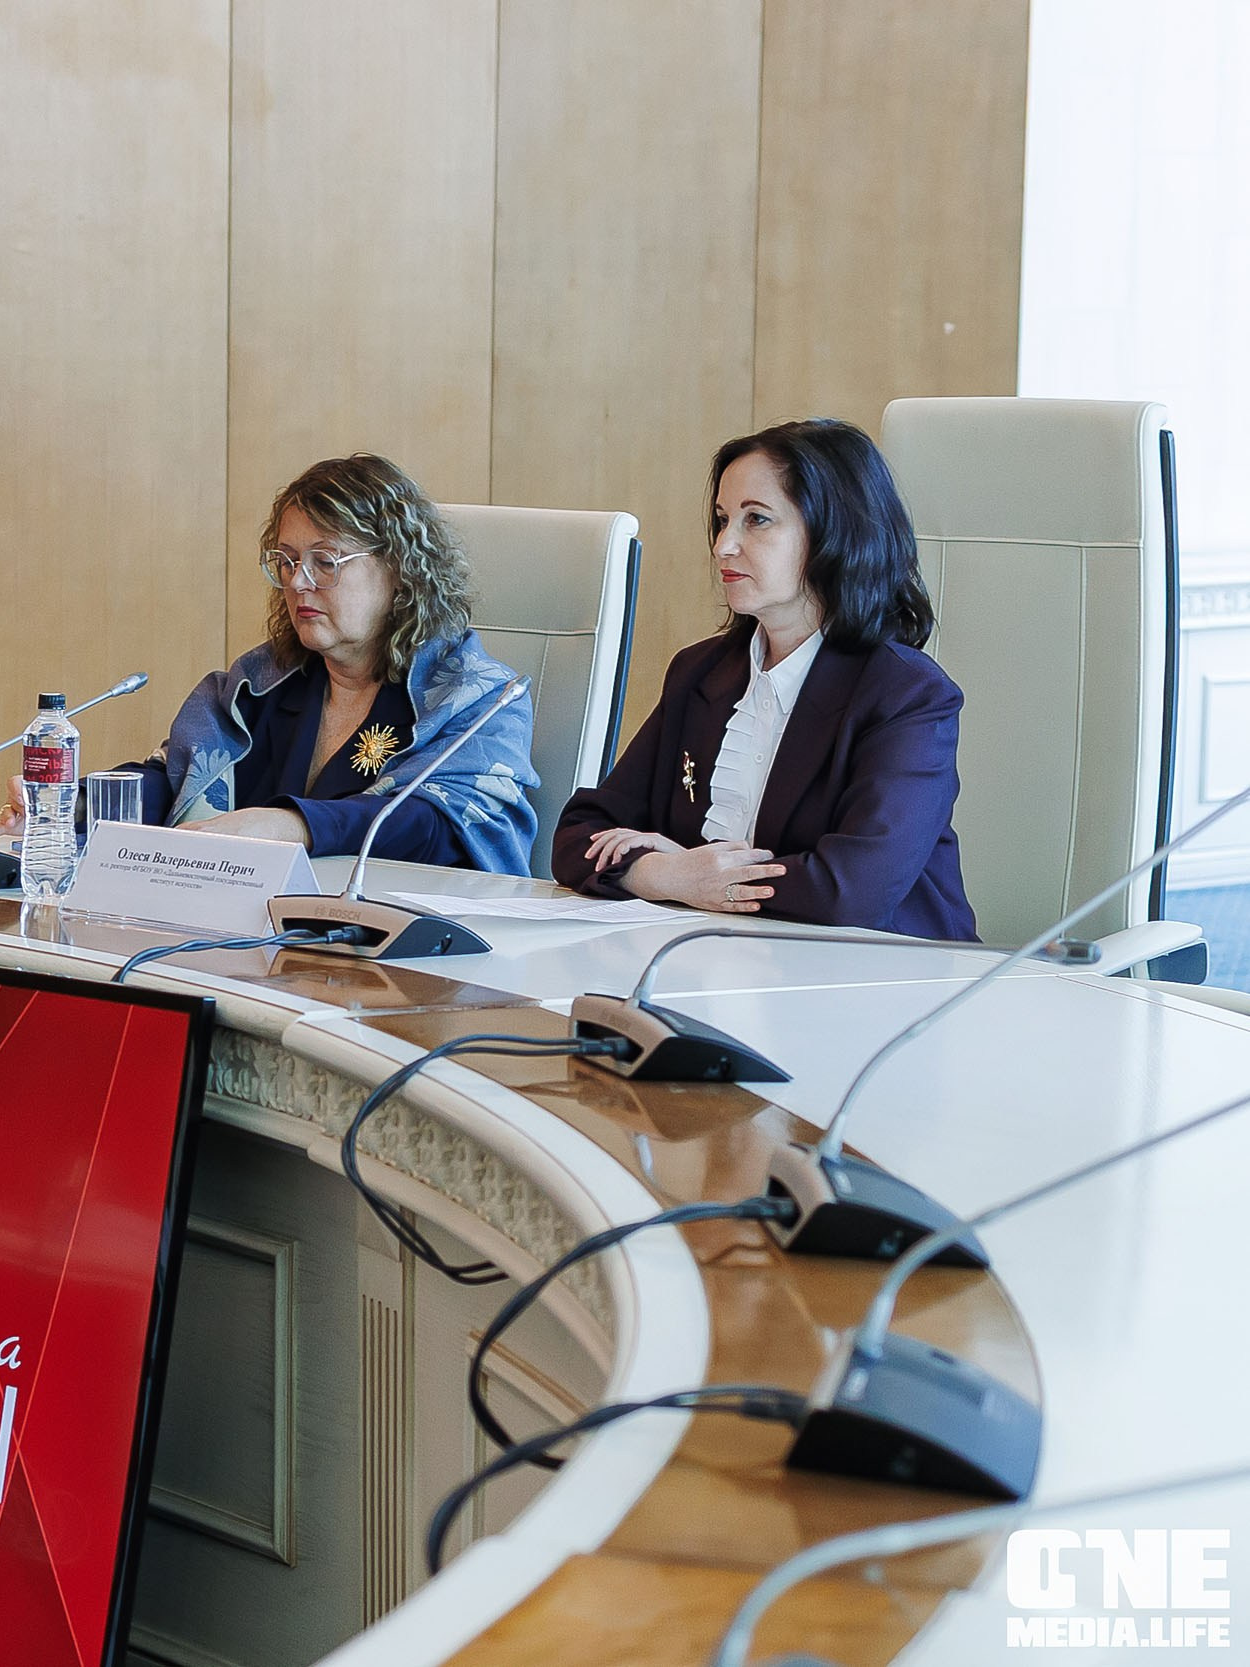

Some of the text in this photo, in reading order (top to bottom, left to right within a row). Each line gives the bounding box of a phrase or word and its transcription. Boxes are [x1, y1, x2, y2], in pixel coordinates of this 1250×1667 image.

[117, 847, 256, 878] Олеся Валерьевна Перич
[328, 908, 361, 920] BOSCH
